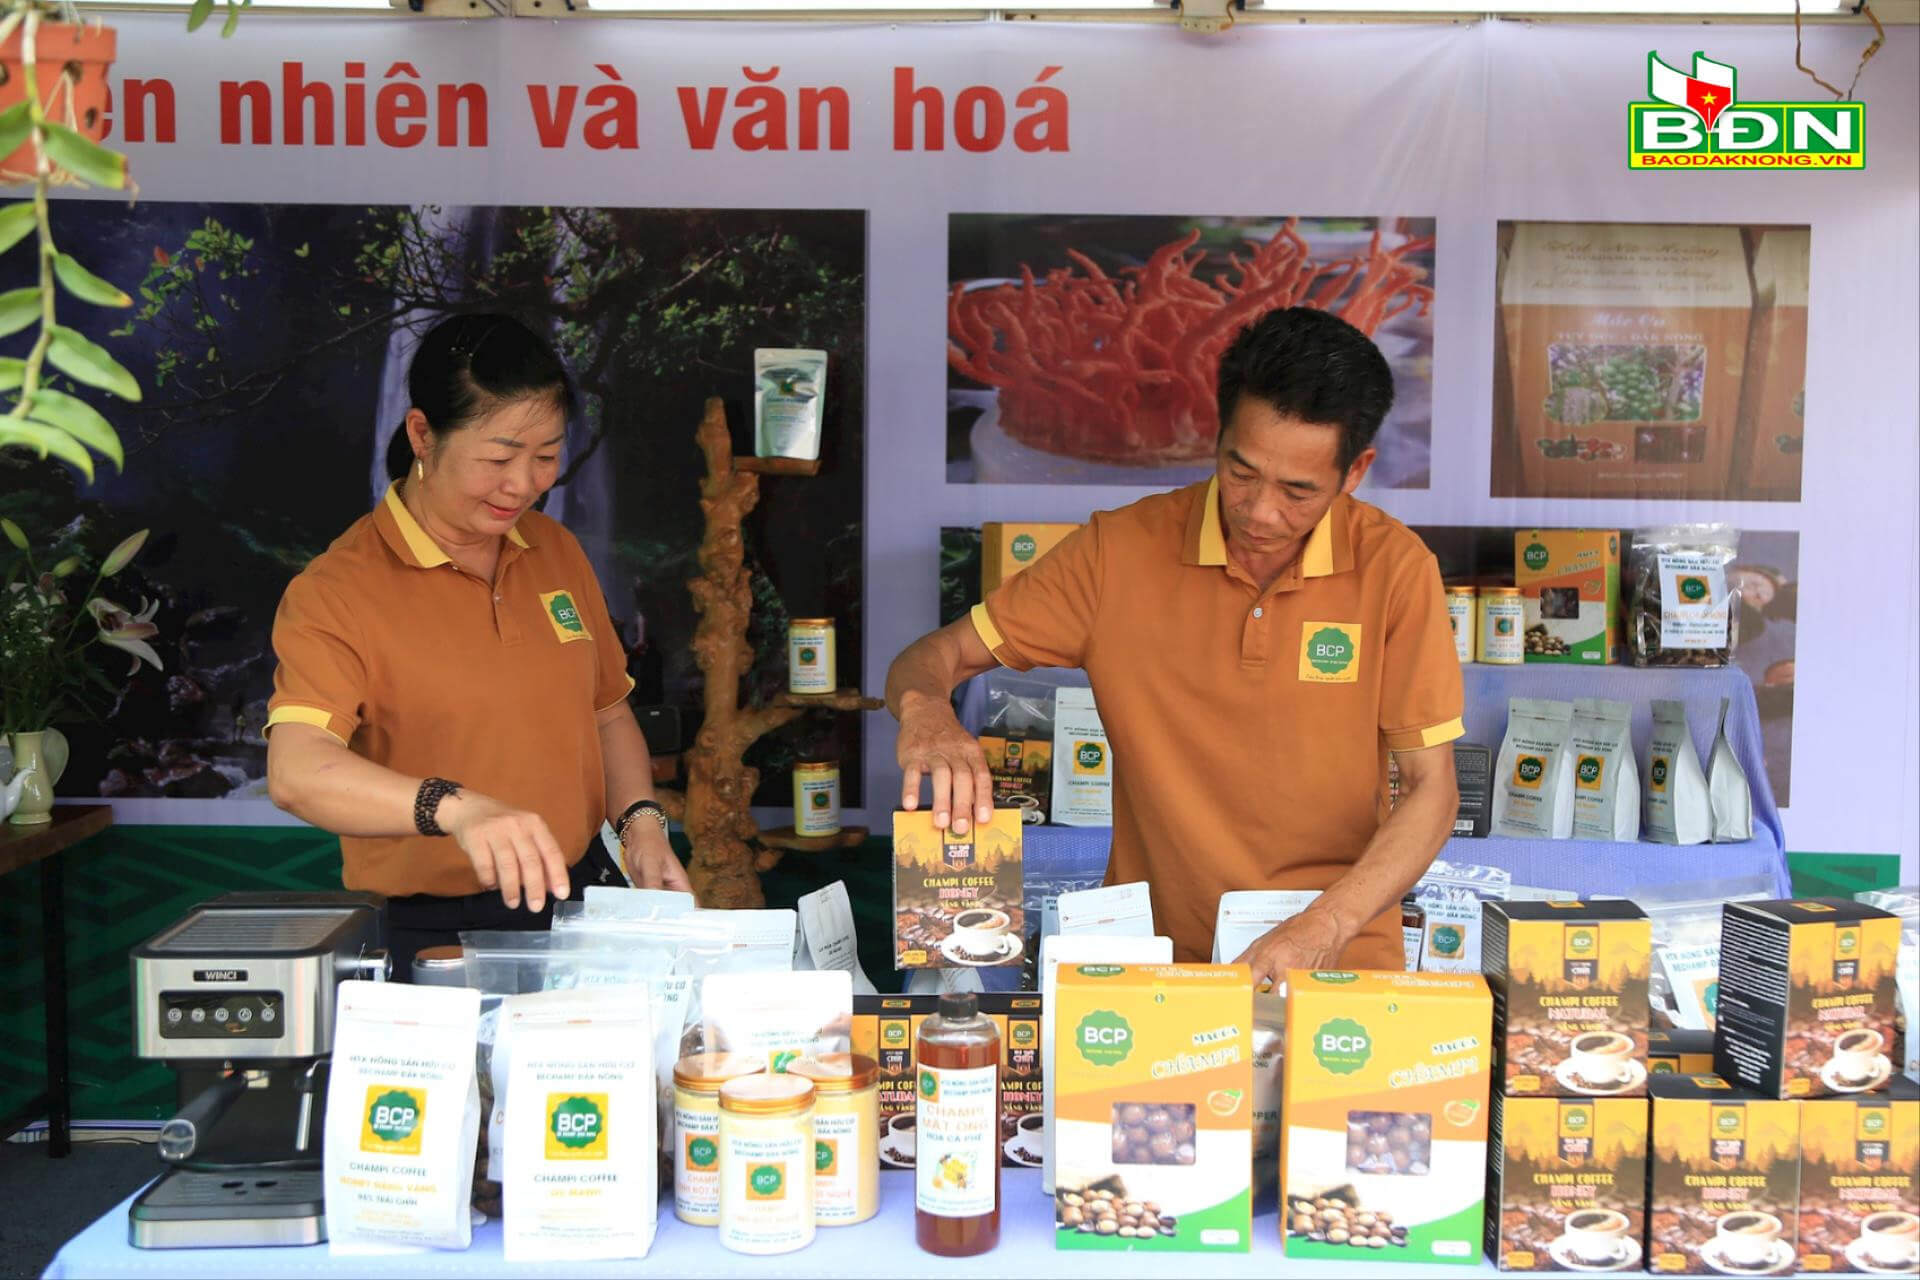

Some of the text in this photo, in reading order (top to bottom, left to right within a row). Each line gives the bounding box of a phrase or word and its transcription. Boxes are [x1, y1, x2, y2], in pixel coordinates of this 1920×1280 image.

[219, 61, 489, 148] nhiên
[526, 64, 640, 149] và
[677, 66, 850, 152] văn
[893, 66, 1071, 153] hoá
[1013, 541, 1035, 553] BCP
[1527, 551, 1547, 561] BCP
[1316, 644, 1345, 657] BCP
[1080, 751, 1101, 761] BCP
[1521, 764, 1541, 776] BCP
[1581, 764, 1598, 775] BCP
[923, 876, 995, 888] CHAMPI COFFEE
[204, 970, 238, 981] WINCI
[1582, 996, 1619, 1007] COFFEE
[887, 1030, 903, 1038] BCP
[1016, 1030, 1031, 1038] BCP
[1084, 1027, 1128, 1045] BCP
[1192, 1025, 1240, 1046] MACCA
[1321, 1034, 1367, 1053] BCP
[1431, 1036, 1479, 1055] MACCA
[879, 1081, 897, 1090] MPI
[1001, 1081, 1026, 1090] AMPI
[376, 1106, 415, 1126] BCP
[558, 1113, 597, 1132] BCP
[693, 1146, 712, 1157] BCP
[815, 1151, 828, 1161] CP
[349, 1162, 428, 1177] CHAMPI COFFEE
[534, 1173, 617, 1184] CHAMPI COFFEE
[756, 1175, 777, 1186] BCP
[1576, 1173, 1615, 1185] COFFEE
[1729, 1175, 1767, 1187] COFFEE
